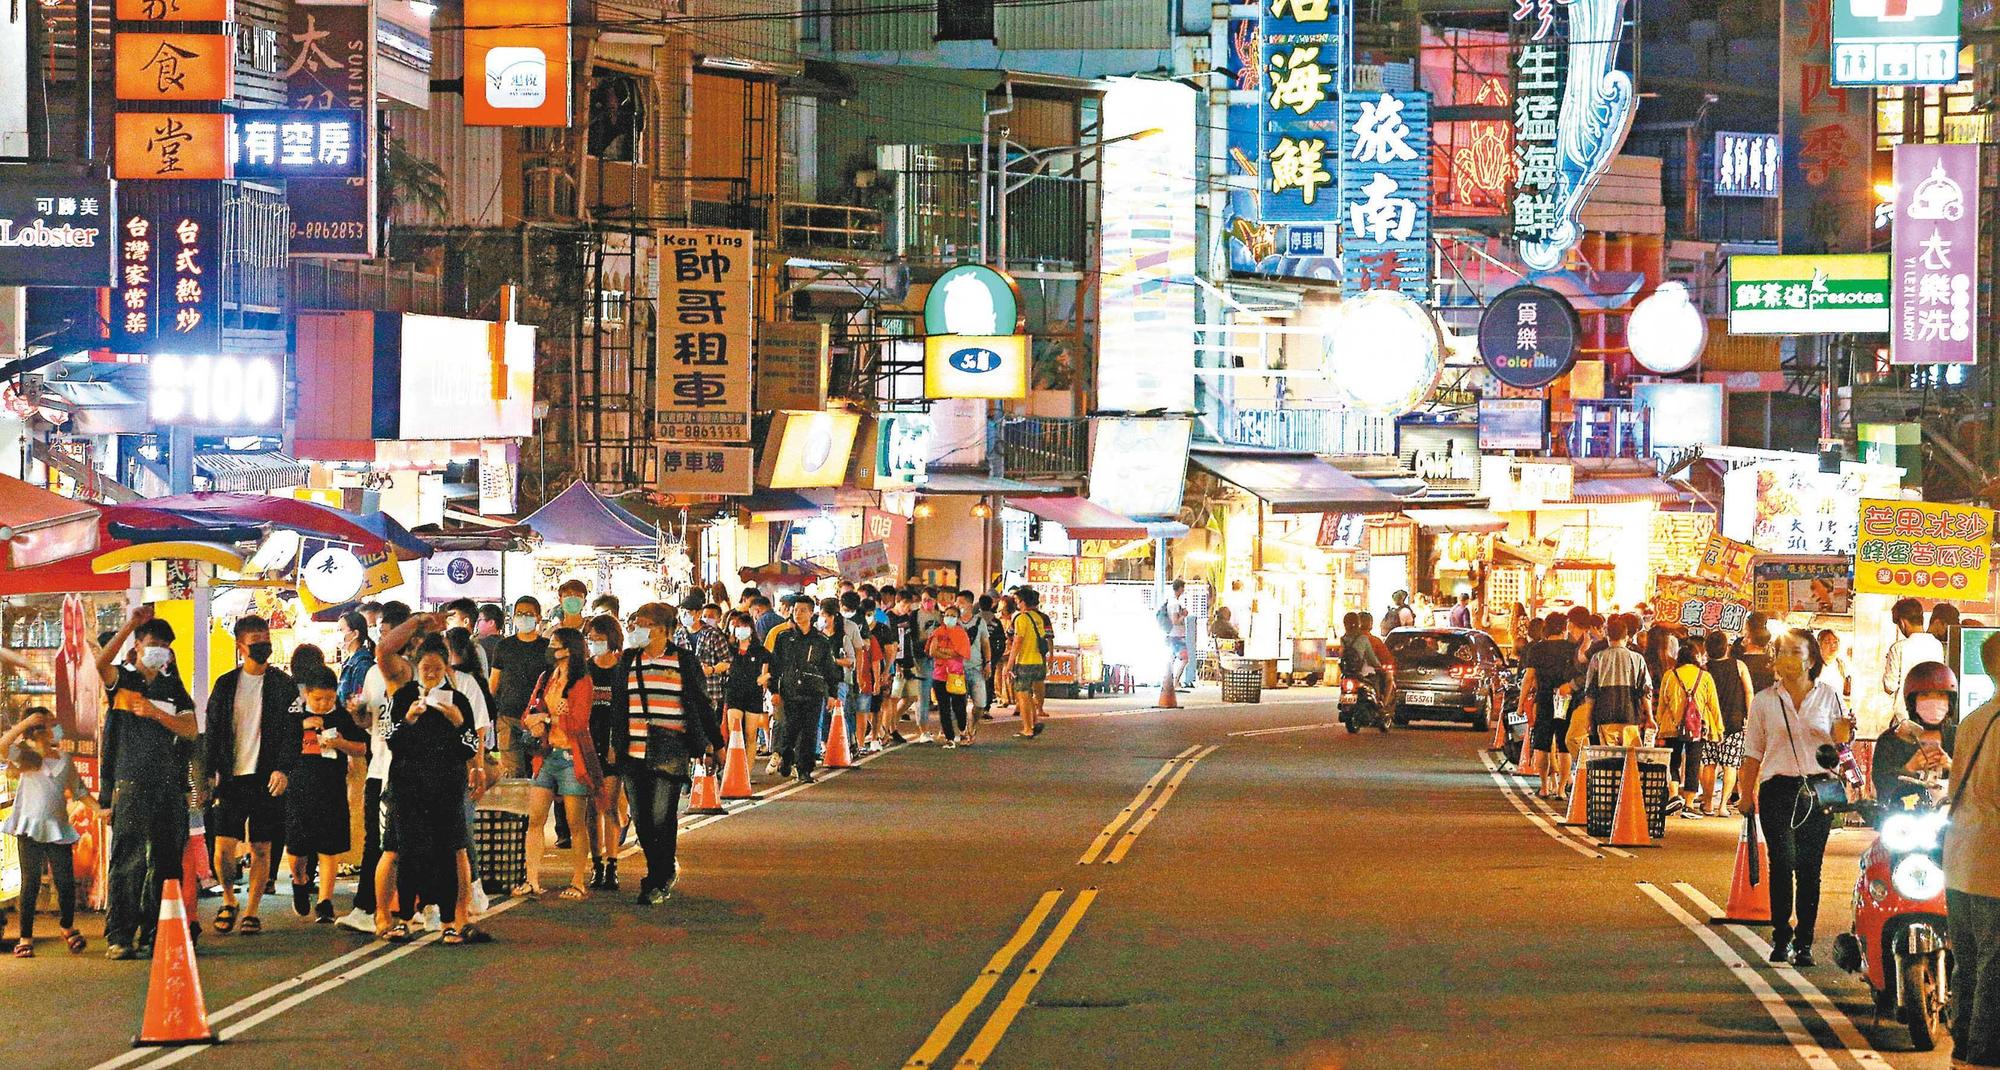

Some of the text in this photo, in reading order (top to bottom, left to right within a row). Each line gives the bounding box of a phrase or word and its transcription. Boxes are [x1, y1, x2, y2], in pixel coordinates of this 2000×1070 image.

[36, 197, 99, 216] 可勝美
[0, 218, 99, 248] Lobster
[663, 233, 743, 248] Ken Ting
[1290, 231, 1325, 255] 停車場
[124, 215, 150, 334] 台灣家常菜
[175, 218, 202, 334] 台式熱炒
[1917, 227, 1952, 342] 衣樂洗
[1736, 282, 1884, 310] 鮮茶道 presotea
[672, 248, 731, 408] 帥哥租車
[1496, 352, 1557, 369] ColorMix
[664, 450, 725, 473] 停車場
[1864, 506, 1988, 541] 芒果冰沙
[1860, 539, 1986, 569] 蜂蜜苦瓜汁
[1876, 567, 1968, 590] 墾丁第一家
